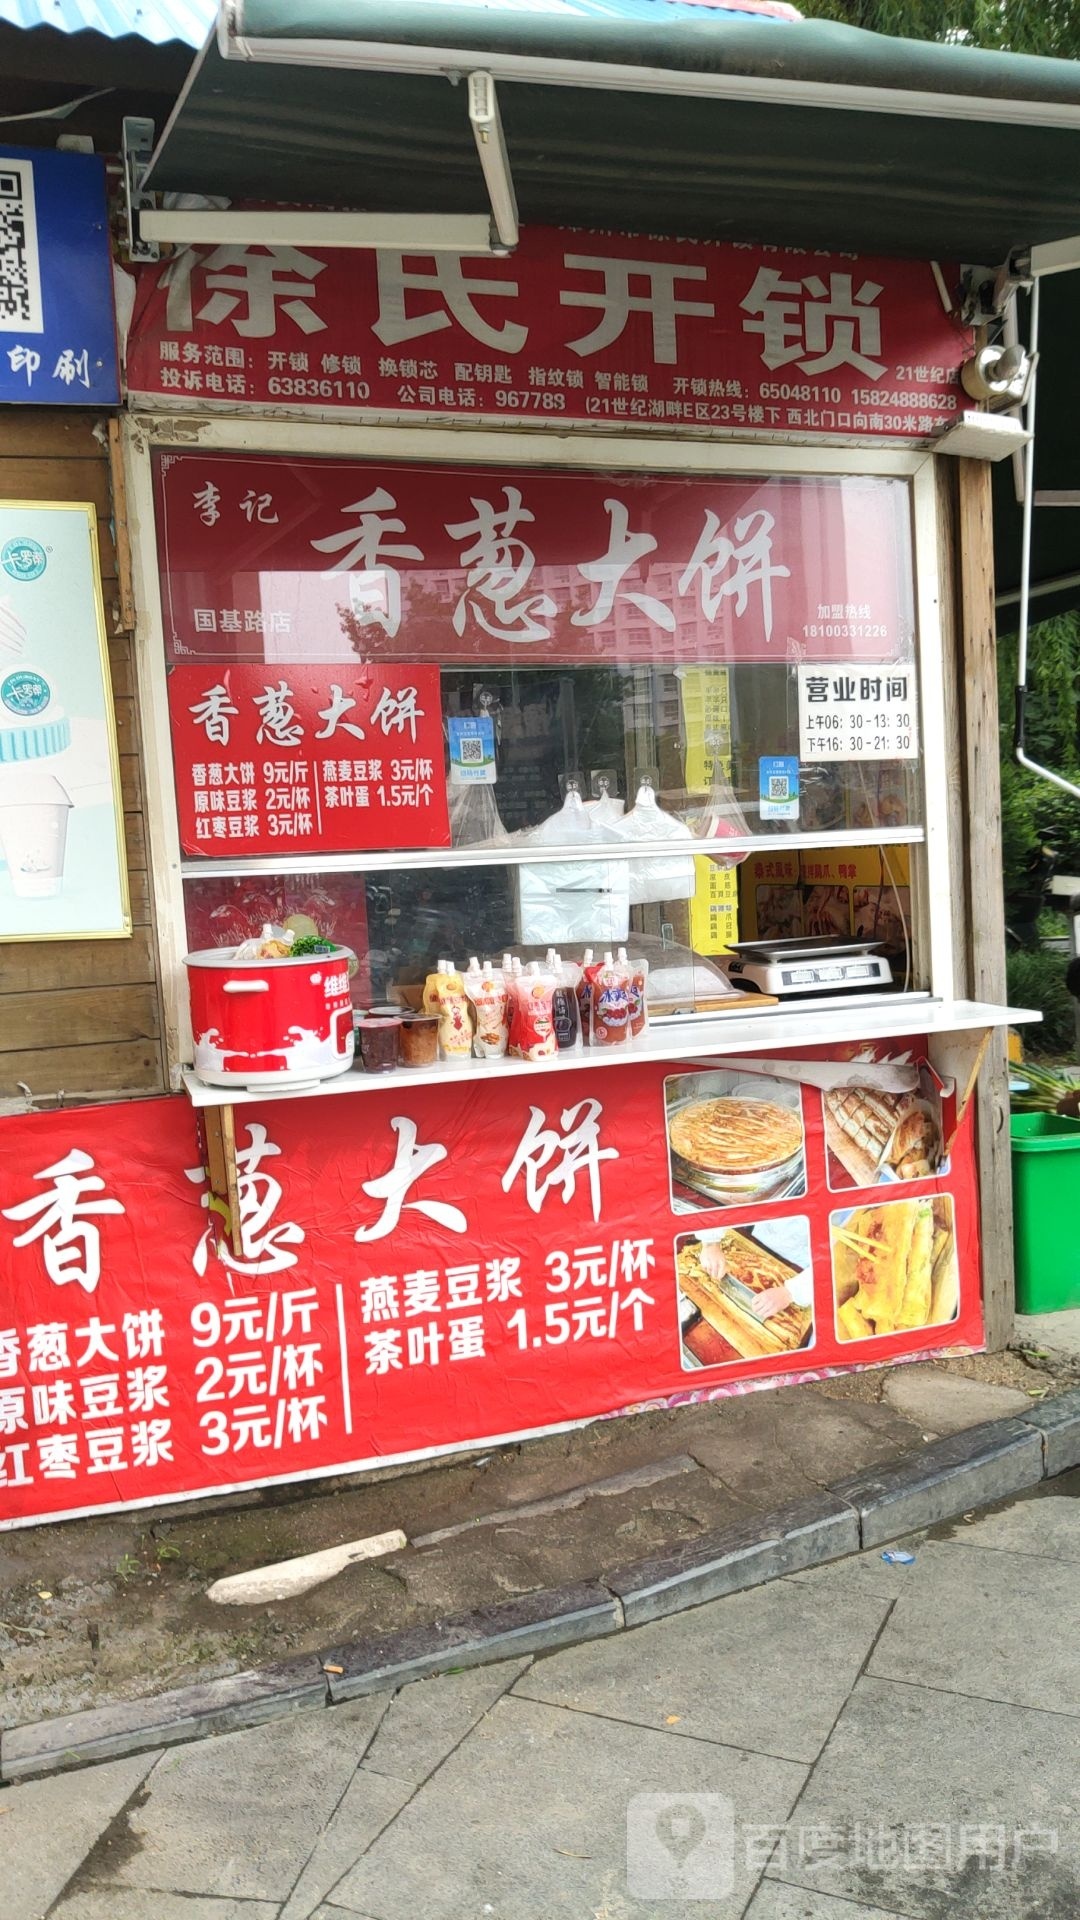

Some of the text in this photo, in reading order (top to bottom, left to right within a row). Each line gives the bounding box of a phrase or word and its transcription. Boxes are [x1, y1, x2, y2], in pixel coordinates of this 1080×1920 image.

[7, 344, 90, 388] 印刷
[159, 341, 649, 393] 服务范围： 开锁 修锁 换锁芯 配钥匙 指纹锁 智能锁
[160, 367, 254, 395] 投诉电话：
[268, 376, 370, 400] 63836110
[397, 384, 484, 407] 公司电话：
[759, 382, 841, 404] 65048110
[851, 388, 957, 411] 15824888628
[192, 481, 279, 526] 李记
[310, 486, 791, 643] 香葱大饼
[194, 608, 292, 633] 国基路店
[802, 624, 888, 638] 18100331226
[817, 603, 871, 620] 加盟热线
[805, 676, 908, 702] 营业时间
[188, 680, 425, 747] 香葱大饼
[192, 760, 309, 786] 香葱大饼 9元/斤
[322, 758, 433, 783] 燕麦豆浆 3元/杯
[194, 788, 311, 813] 原味豆浆 2元/杯
[324, 784, 434, 808] 茶叶蛋 1.5元/个
[195, 813, 313, 839] 红枣豆浆 3元/杯
[1, 1098, 619, 1293] 香葱大饼
[360, 1239, 656, 1324] 燕麦豆浆 3元/杯
[190, 1287, 320, 1348] 9元/斤
[363, 1288, 655, 1375] 茶叶蛋 1.5元/个
[194, 1343, 324, 1403] 2元/杯
[0, 1395, 328, 1488] 红枣豆浆 3元/杯
